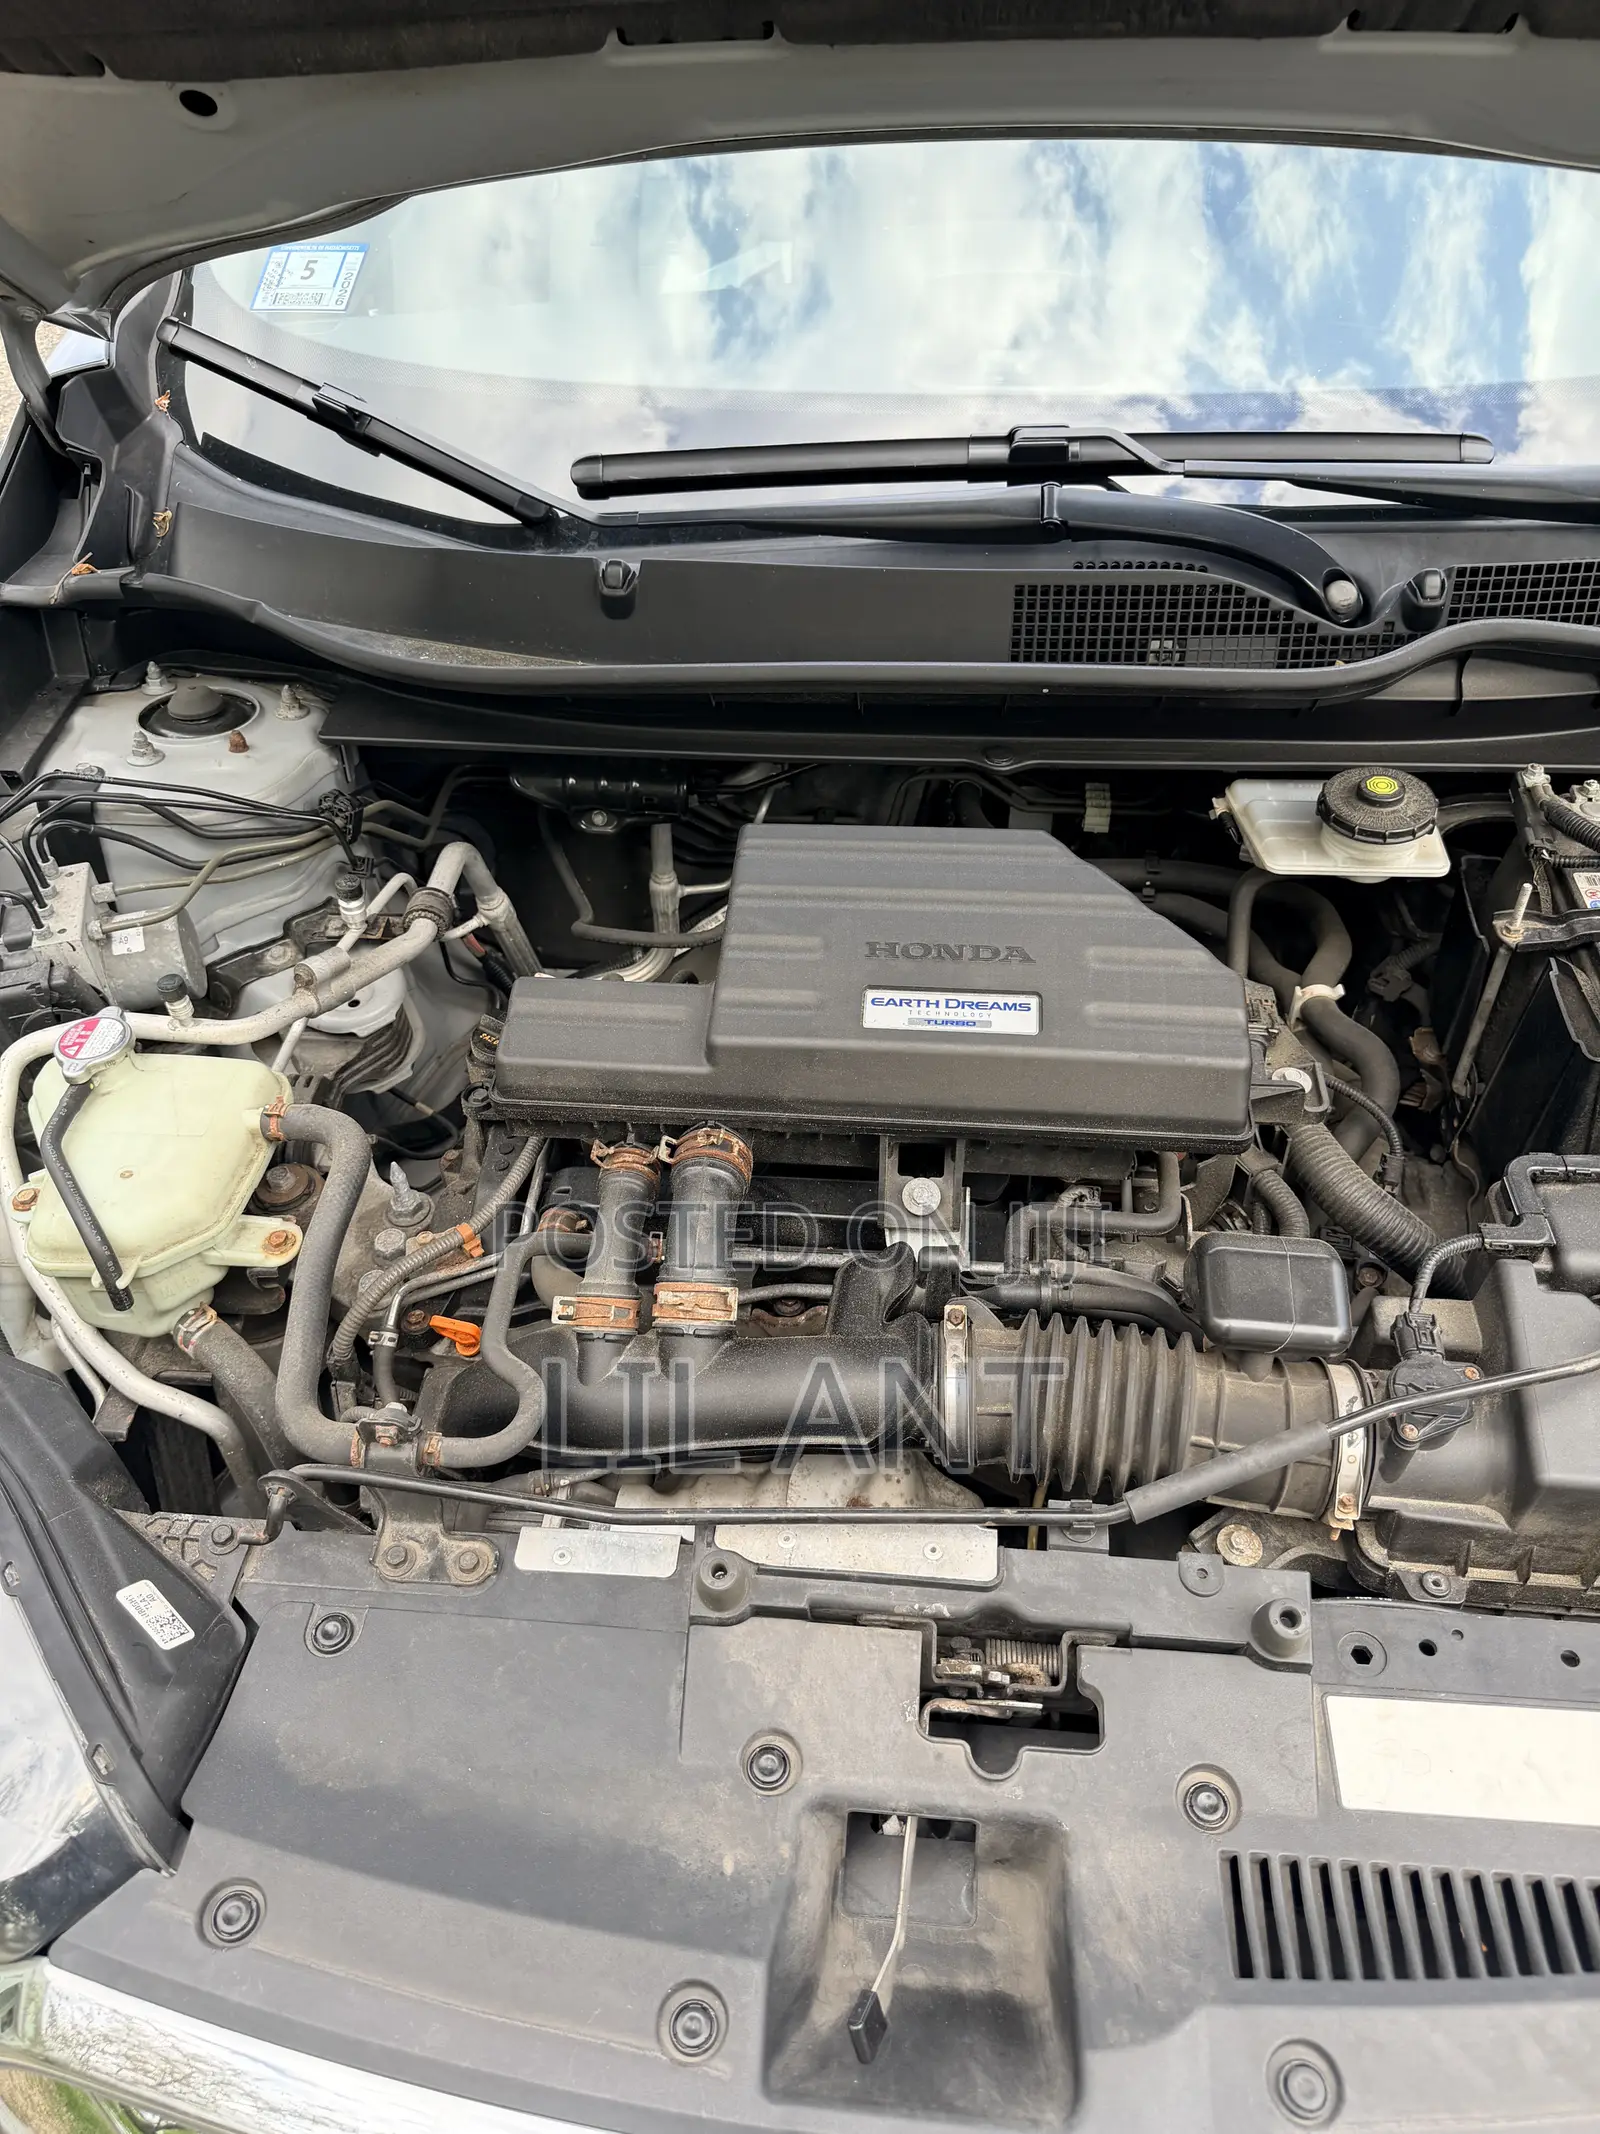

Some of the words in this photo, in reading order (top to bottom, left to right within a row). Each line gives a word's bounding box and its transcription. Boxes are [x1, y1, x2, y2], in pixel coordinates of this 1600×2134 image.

[300, 260, 318, 280] 5
[335, 272, 354, 306] 2026
[864, 941, 1037, 964] HONDA
[871, 997, 940, 1008] EARTH
[908, 1009, 992, 1017] TECHNOLOGY
[923, 1019, 977, 1027] TURBO
